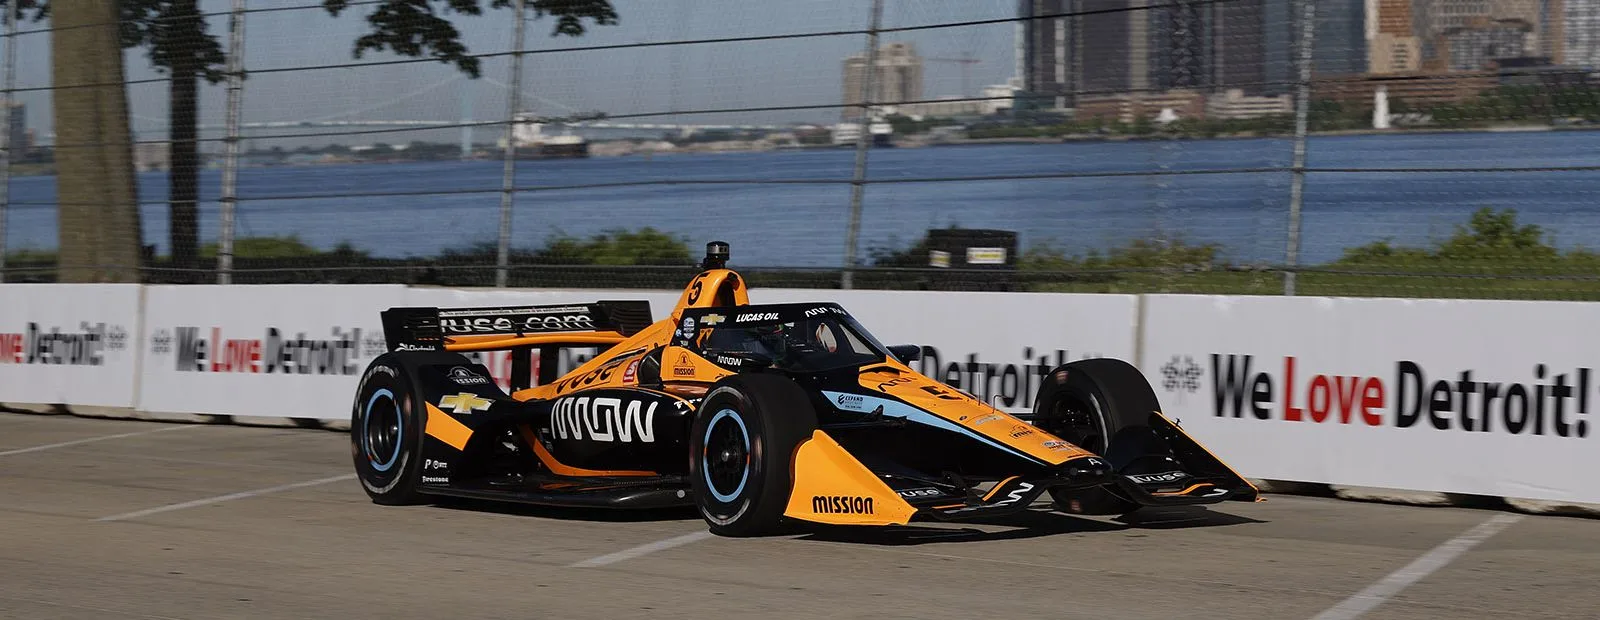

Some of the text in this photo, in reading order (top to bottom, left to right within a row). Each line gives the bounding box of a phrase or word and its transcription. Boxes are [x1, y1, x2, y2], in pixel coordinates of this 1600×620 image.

[688, 272, 711, 306] 5
[735, 312, 779, 323] LUCAS OIL
[175, 326, 362, 375] We Love Detroit!
[920, 345, 1067, 408] Detroit
[1209, 353, 1592, 438] We Love Detroit!
